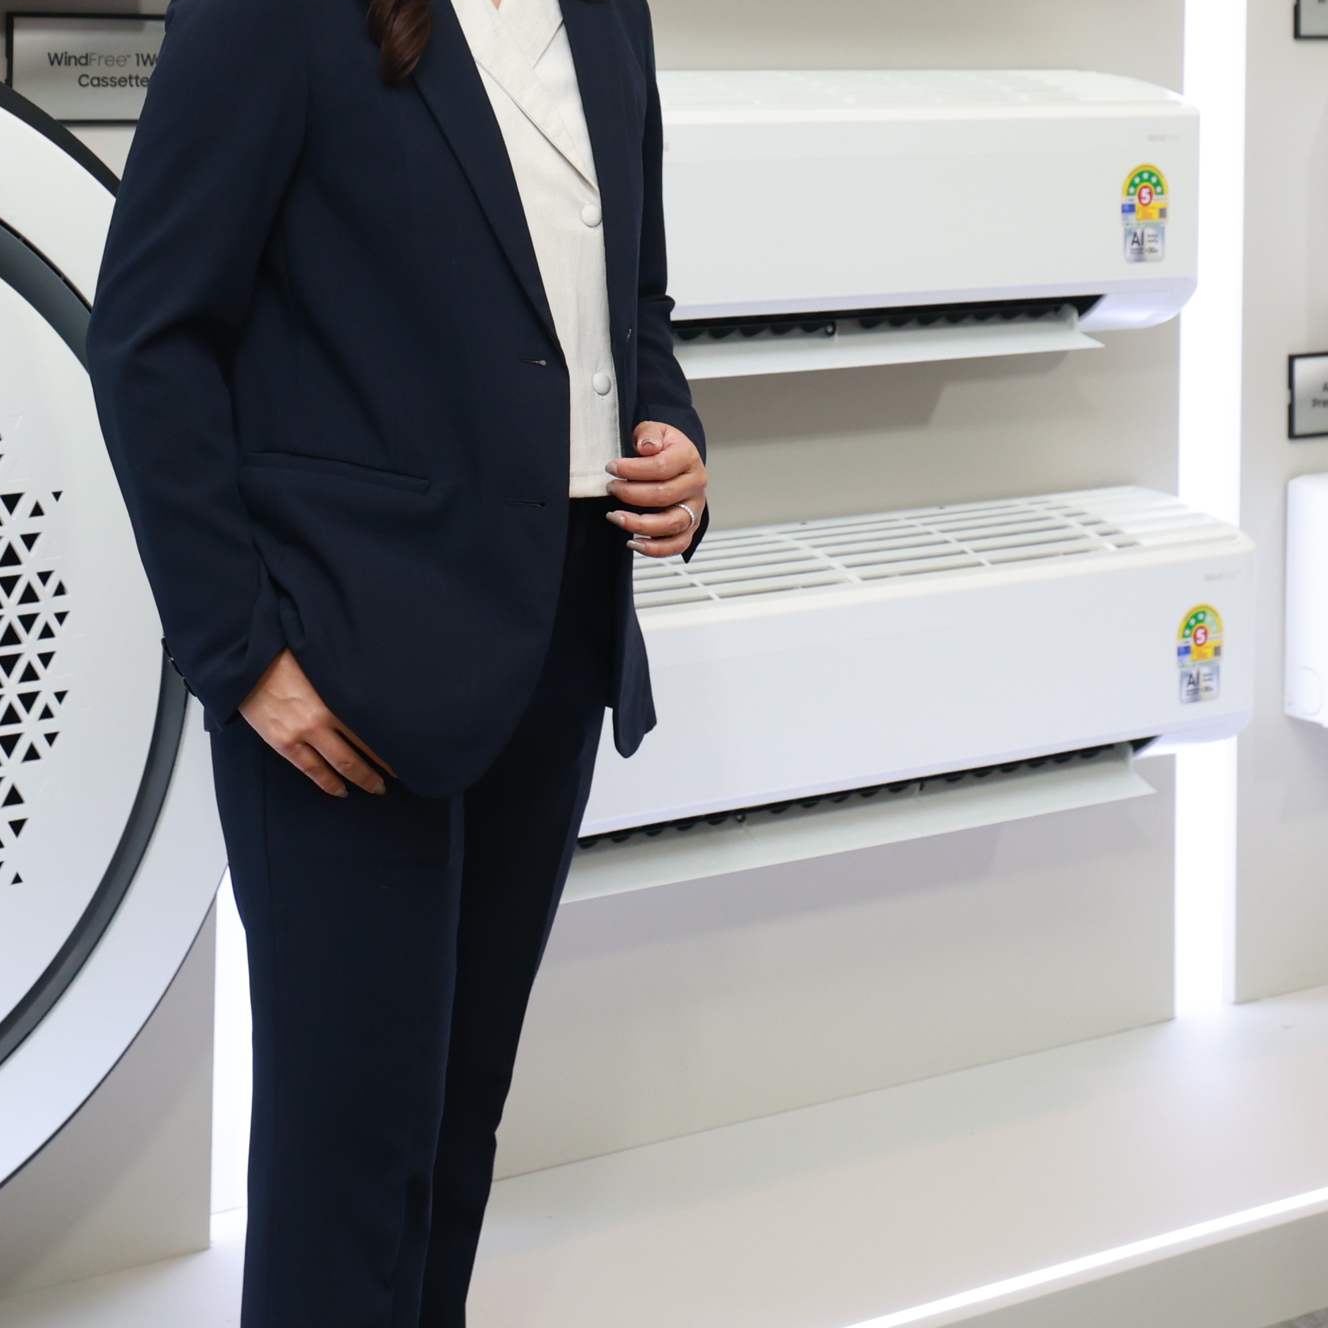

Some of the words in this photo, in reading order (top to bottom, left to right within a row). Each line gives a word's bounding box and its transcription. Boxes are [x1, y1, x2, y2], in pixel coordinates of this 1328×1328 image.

[135, 52, 158, 67] 1W
[78, 73, 150, 88] Cassette
[1140, 187, 1151, 205] 5
